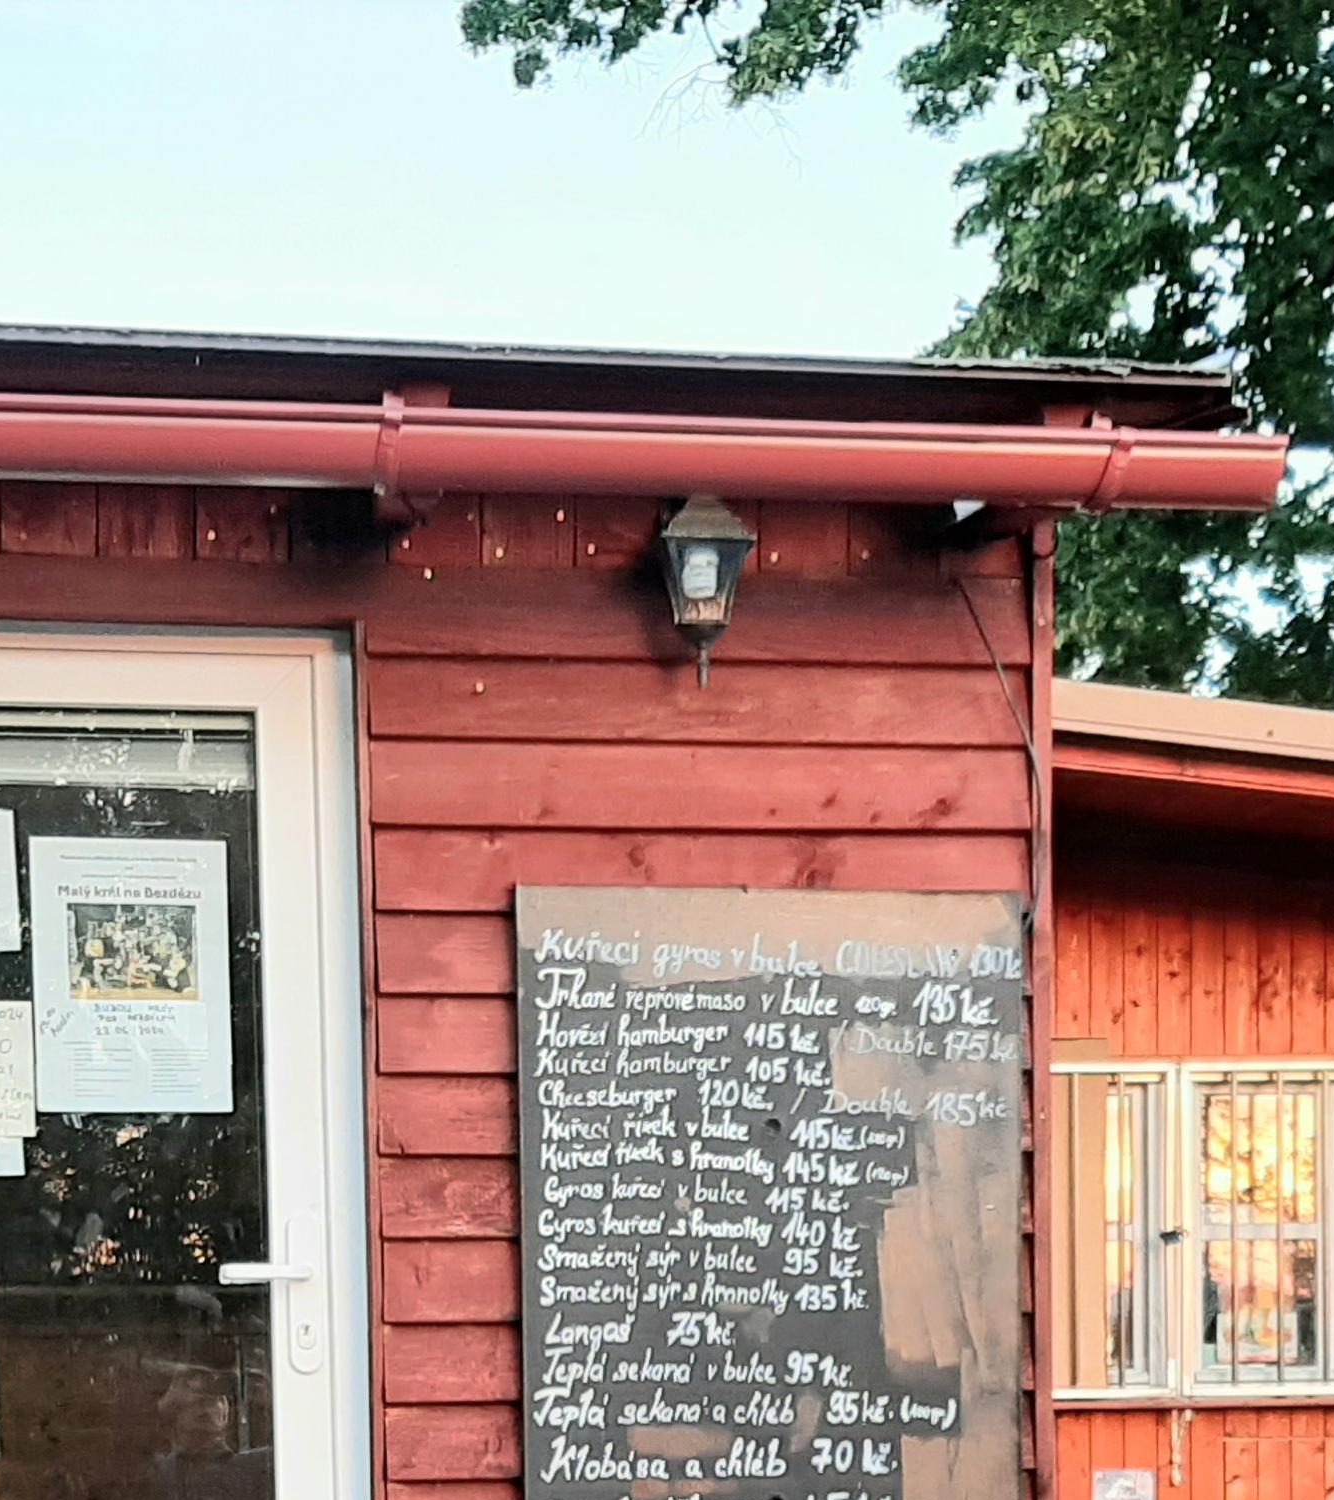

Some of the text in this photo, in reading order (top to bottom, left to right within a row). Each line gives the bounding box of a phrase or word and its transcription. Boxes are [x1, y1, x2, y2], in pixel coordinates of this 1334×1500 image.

[58, 885, 91, 898] Malý
[124, 888, 141, 898] na
[653, 942, 721, 978] gyros
[731, 949, 745, 967] v
[749, 933, 822, 977] bulce
[535, 967, 617, 1010] Trhané
[696, 993, 747, 1011] maso
[761, 993, 775, 1013] v
[780, 977, 839, 1016] bulce
[912, 981, 960, 1026] 135
[536, 1011, 609, 1047] Hovězí
[617, 1013, 729, 1054] hamburger
[743, 1022, 786, 1050] 115
[856, 1027, 938, 1058] Double
[533, 1049, 611, 1078] Kuřecí
[617, 1048, 732, 1081] hamburger
[745, 1055, 789, 1084] 105
[538, 1079, 678, 1114] Cheeseburger
[698, 1079, 740, 1107] 120
[819, 1087, 913, 1121] Double
[925, 1092, 978, 1127] 185
[541, 1108, 612, 1141] Kuřecí
[684, 1121, 698, 1136] v
[701, 1105, 750, 1141] bulce
[789, 1118, 834, 1150] 115
[689, 1141, 775, 1184] hranolky
[782, 1151, 825, 1184] 145
[544, 1175, 604, 1208] Gyros
[678, 1183, 689, 1198] v
[694, 1173, 748, 1204] bulce
[764, 1186, 807, 1214] 115
[538, 1208, 596, 1243] Gyros
[690, 1207, 773, 1247] hranolky
[781, 1211, 826, 1246] 140
[537, 1242, 641, 1277] Smažený
[645, 1241, 681, 1277] sýr
[689, 1250, 700, 1267] v
[703, 1242, 757, 1273] bulce
[782, 1248, 820, 1276] 95
[539, 1275, 640, 1312] Smažený
[642, 1274, 681, 1310] sýr
[700, 1272, 790, 1314] hranolky
[794, 1282, 837, 1311] 135
[667, 1311, 706, 1346] 75
[542, 1347, 607, 1392] Teplá
[612, 1347, 695, 1384] sekaná
[707, 1364, 717, 1381] v
[723, 1350, 777, 1385] bulce
[784, 1350, 818, 1385] 95
[533, 1386, 610, 1433] Teplá
[617, 1387, 708, 1425] sekaná
[712, 1407, 726, 1424] a
[733, 1391, 795, 1427] chléb
[826, 1390, 860, 1425] 95
[540, 1435, 670, 1484] Klobása
[685, 1459, 704, 1479] a
[715, 1436, 787, 1478] chléb
[811, 1437, 854, 1474] 70
